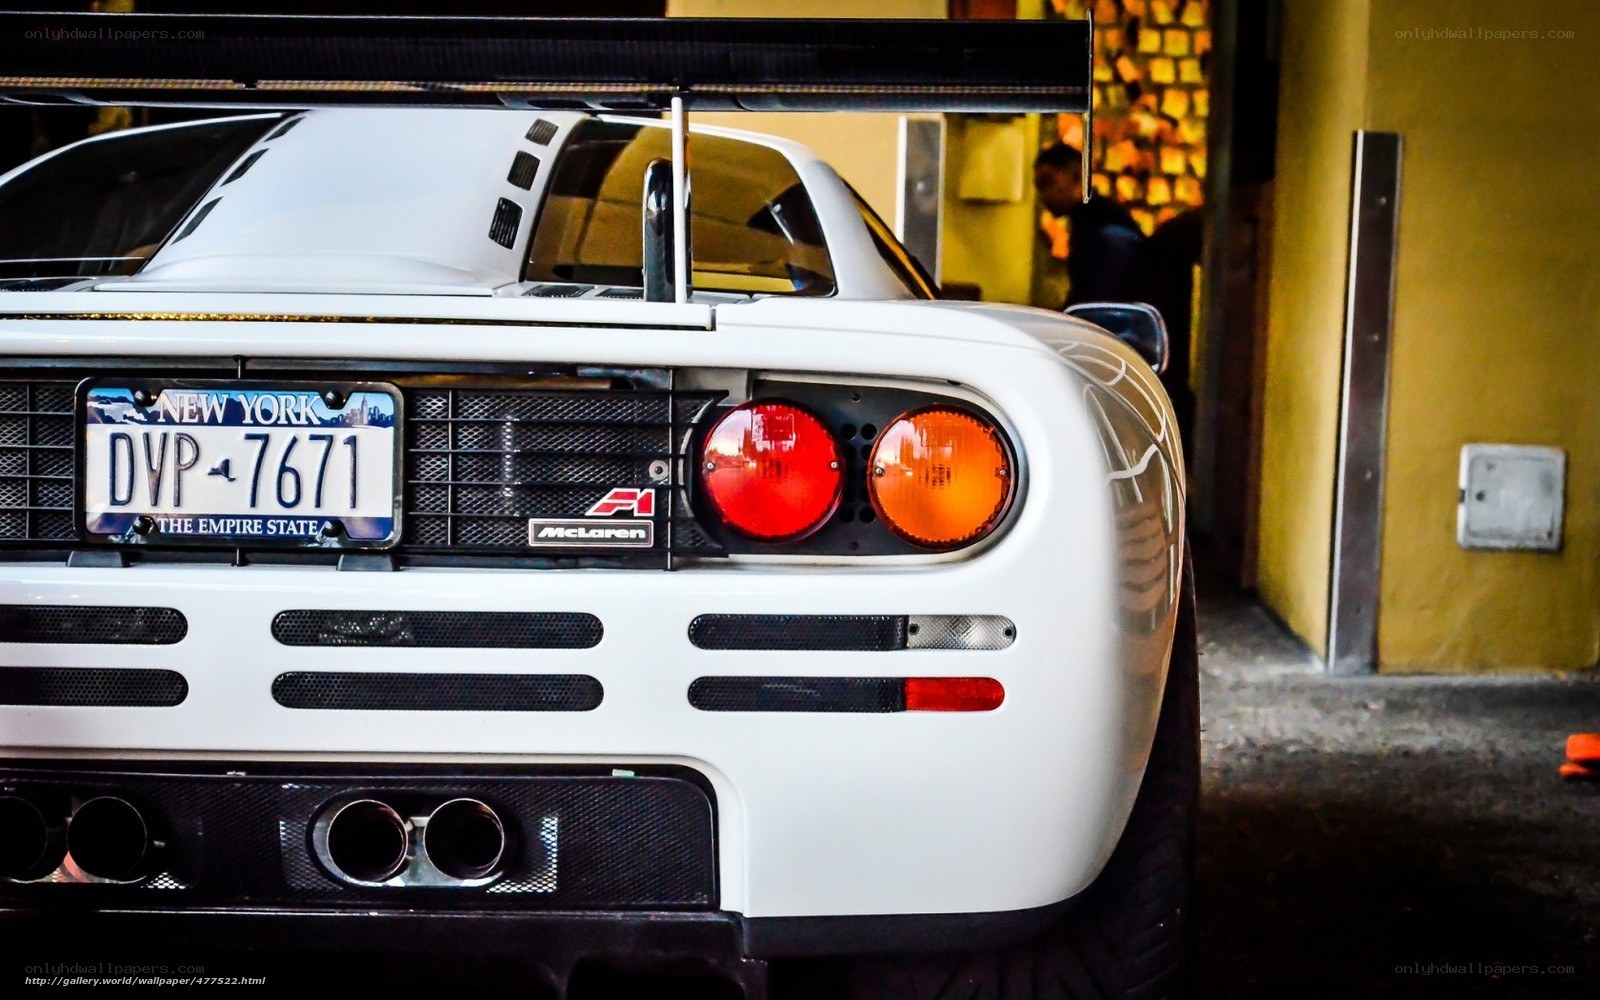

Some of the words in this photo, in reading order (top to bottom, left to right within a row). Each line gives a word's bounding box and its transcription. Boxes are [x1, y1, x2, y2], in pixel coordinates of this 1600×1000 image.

[157, 391, 229, 424] NEW
[238, 393, 322, 425] YORK
[109, 432, 200, 508] DVP
[243, 433, 358, 509] 7671
[157, 517, 194, 534] THE
[198, 518, 263, 535] EMPIRE
[266, 520, 319, 536] STATE
[537, 527, 646, 539] McLaren
